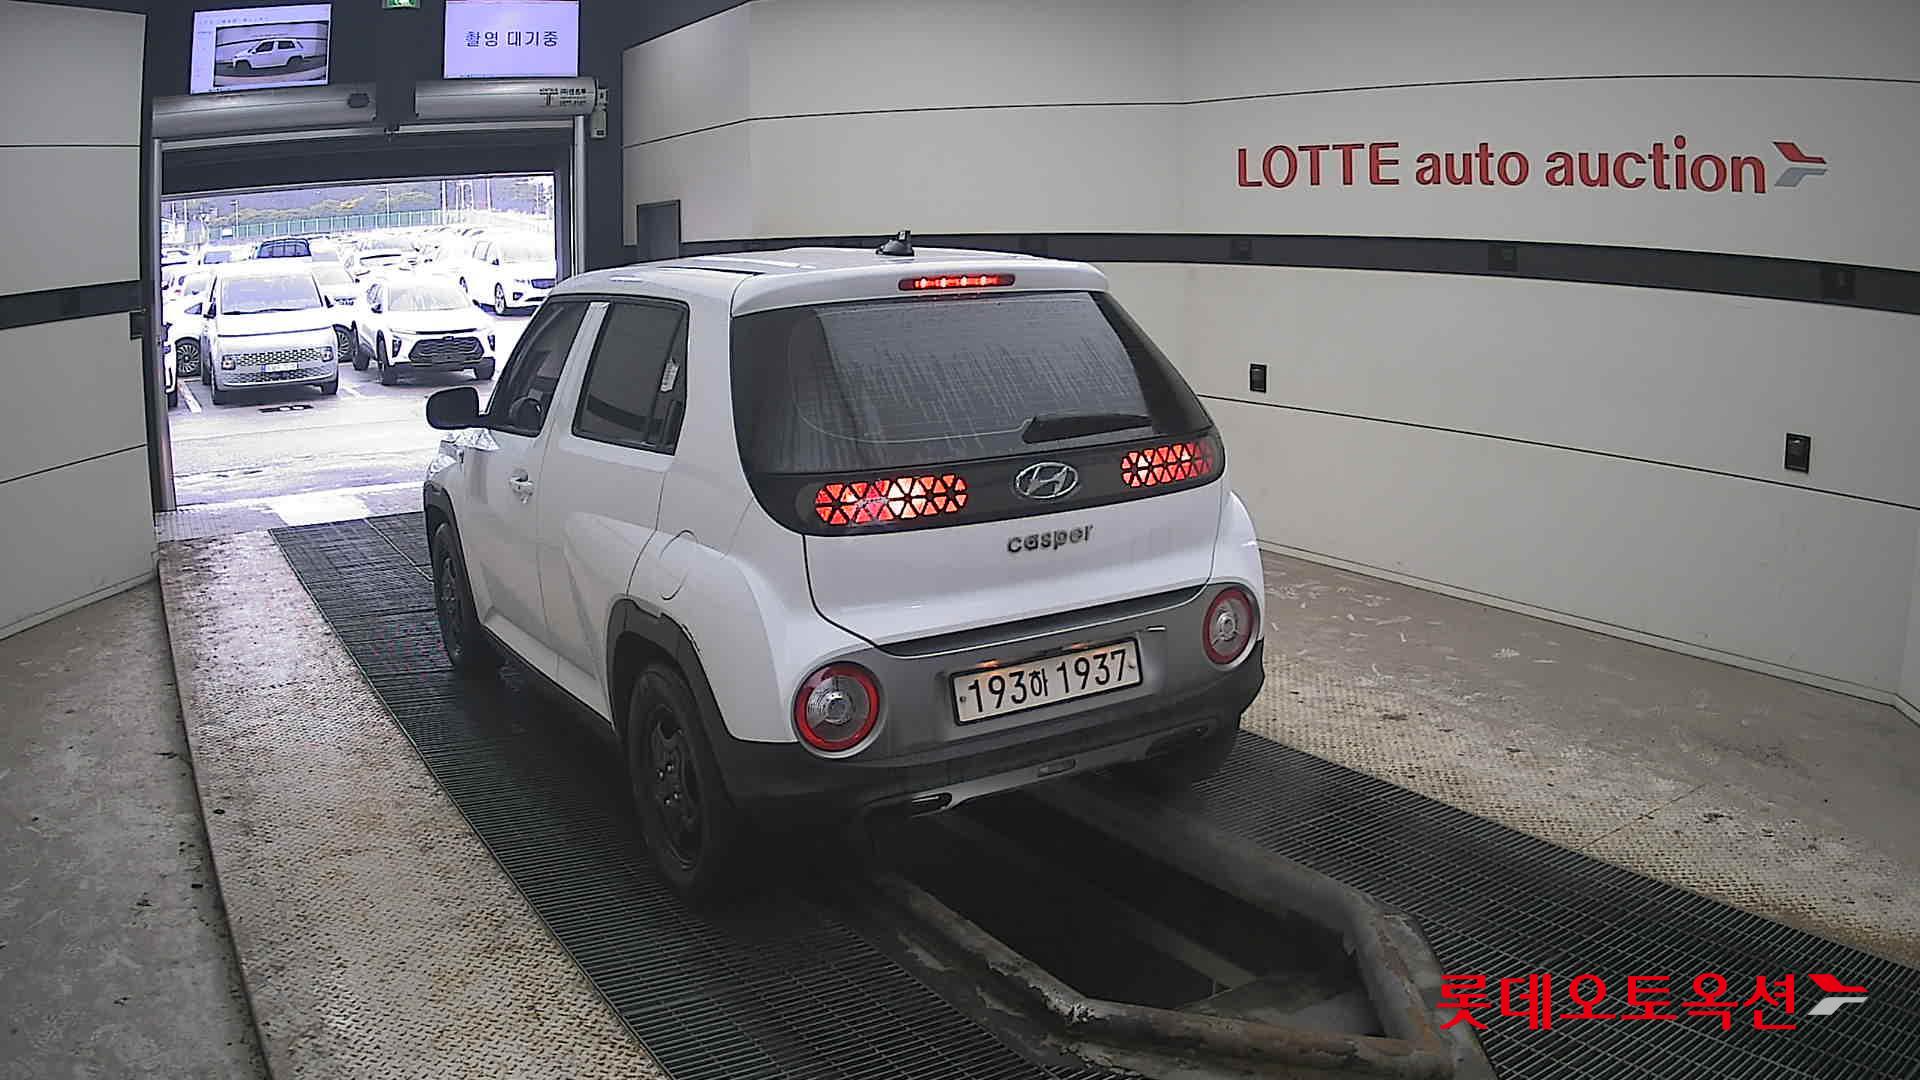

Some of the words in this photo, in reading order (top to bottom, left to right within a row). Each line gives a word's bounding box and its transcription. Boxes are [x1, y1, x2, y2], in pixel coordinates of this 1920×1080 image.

[507, 31, 558, 47] 대기중
[1238, 142, 1399, 187] LOTTE
[1416, 142, 1529, 186] auto
[1545, 135, 1766, 194] auction
[1007, 525, 1094, 553] casper
[968, 667, 1048, 713] 193하
[1056, 649, 1127, 694] 1937
